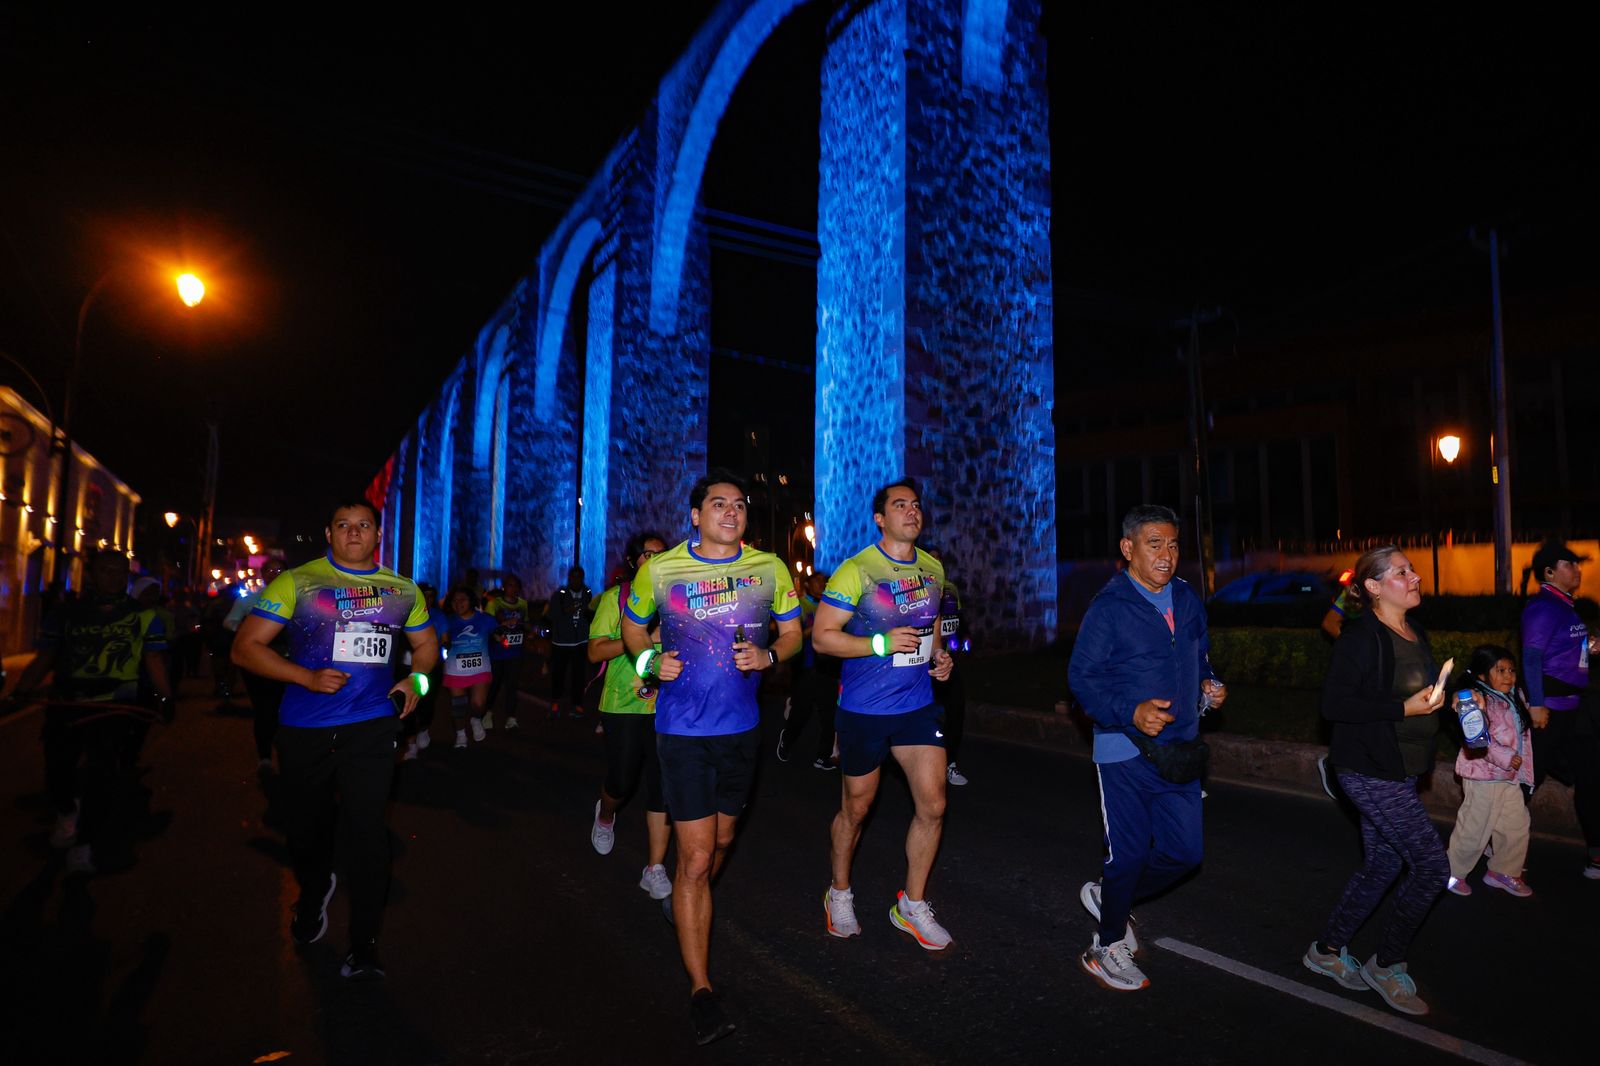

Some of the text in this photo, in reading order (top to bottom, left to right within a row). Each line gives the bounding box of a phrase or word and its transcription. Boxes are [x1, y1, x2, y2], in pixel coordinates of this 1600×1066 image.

[686, 575, 763, 597] CARRERA 2025
[890, 575, 922, 594] CARRERA
[335, 586, 375, 600] CARRERA
[894, 588, 930, 606] NOCTURNA
[337, 597, 383, 610] NOCTURNA
[689, 591, 738, 610] NOCTURNA
[908, 598, 931, 610] CGV
[353, 607, 384, 617] CGV
[706, 602, 739, 616] CGV
[461, 658, 482, 669] 3663
